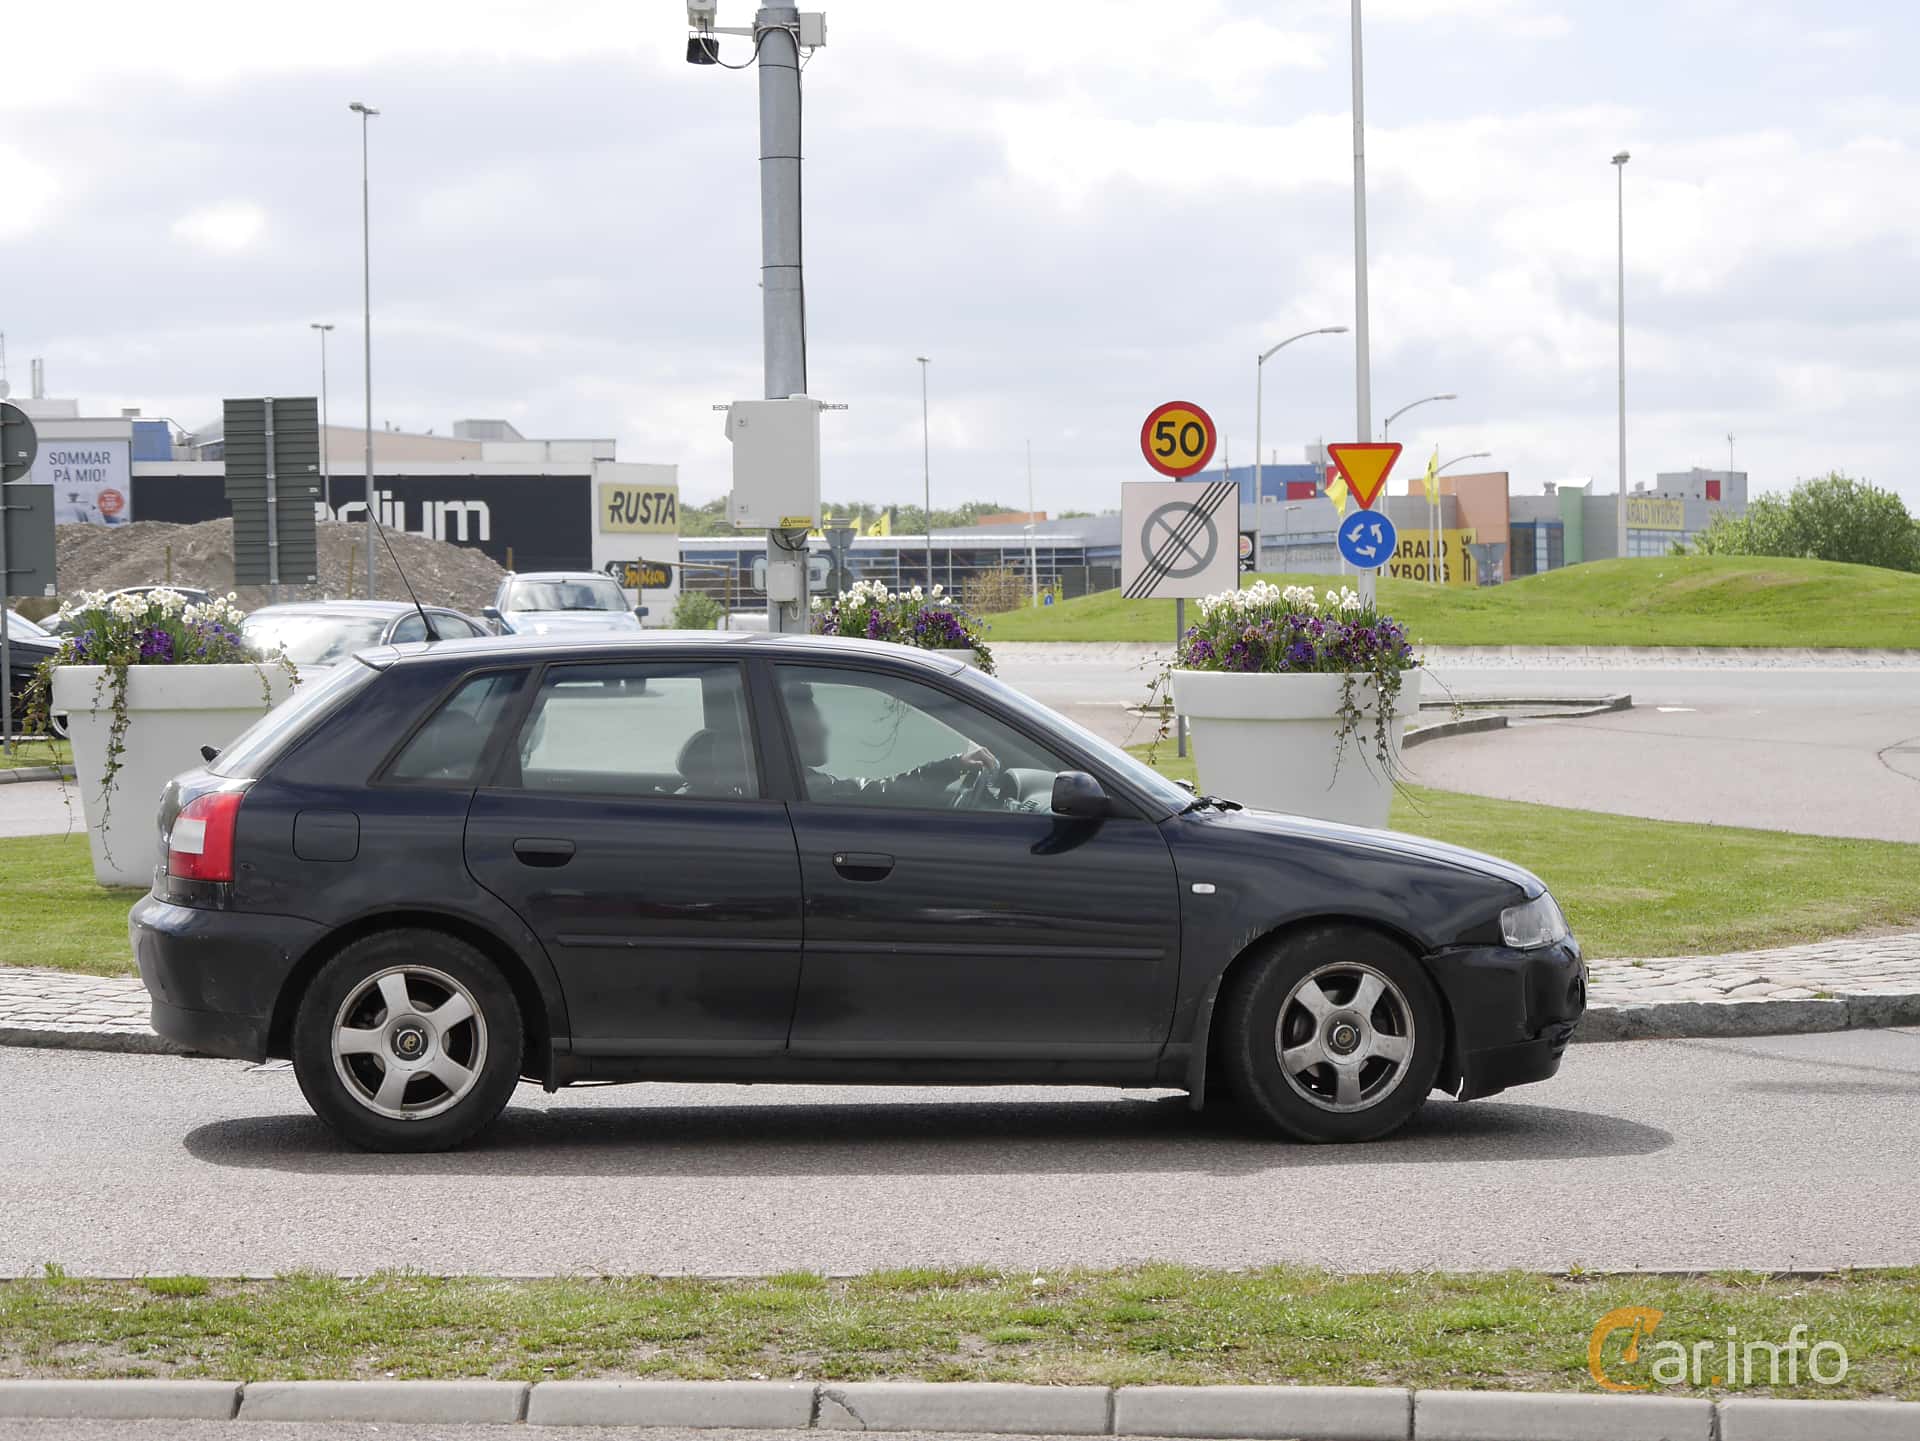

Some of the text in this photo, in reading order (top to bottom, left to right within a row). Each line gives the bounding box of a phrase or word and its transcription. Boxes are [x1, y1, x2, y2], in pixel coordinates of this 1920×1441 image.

[1155, 421, 1205, 457] 50
[48, 451, 111, 465] SOMMAR
[53, 467, 106, 482] PÅ MIO!
[608, 490, 676, 525] RUSTA
[1387, 539, 1448, 558] ARALD
[1376, 563, 1450, 582] YBORG
